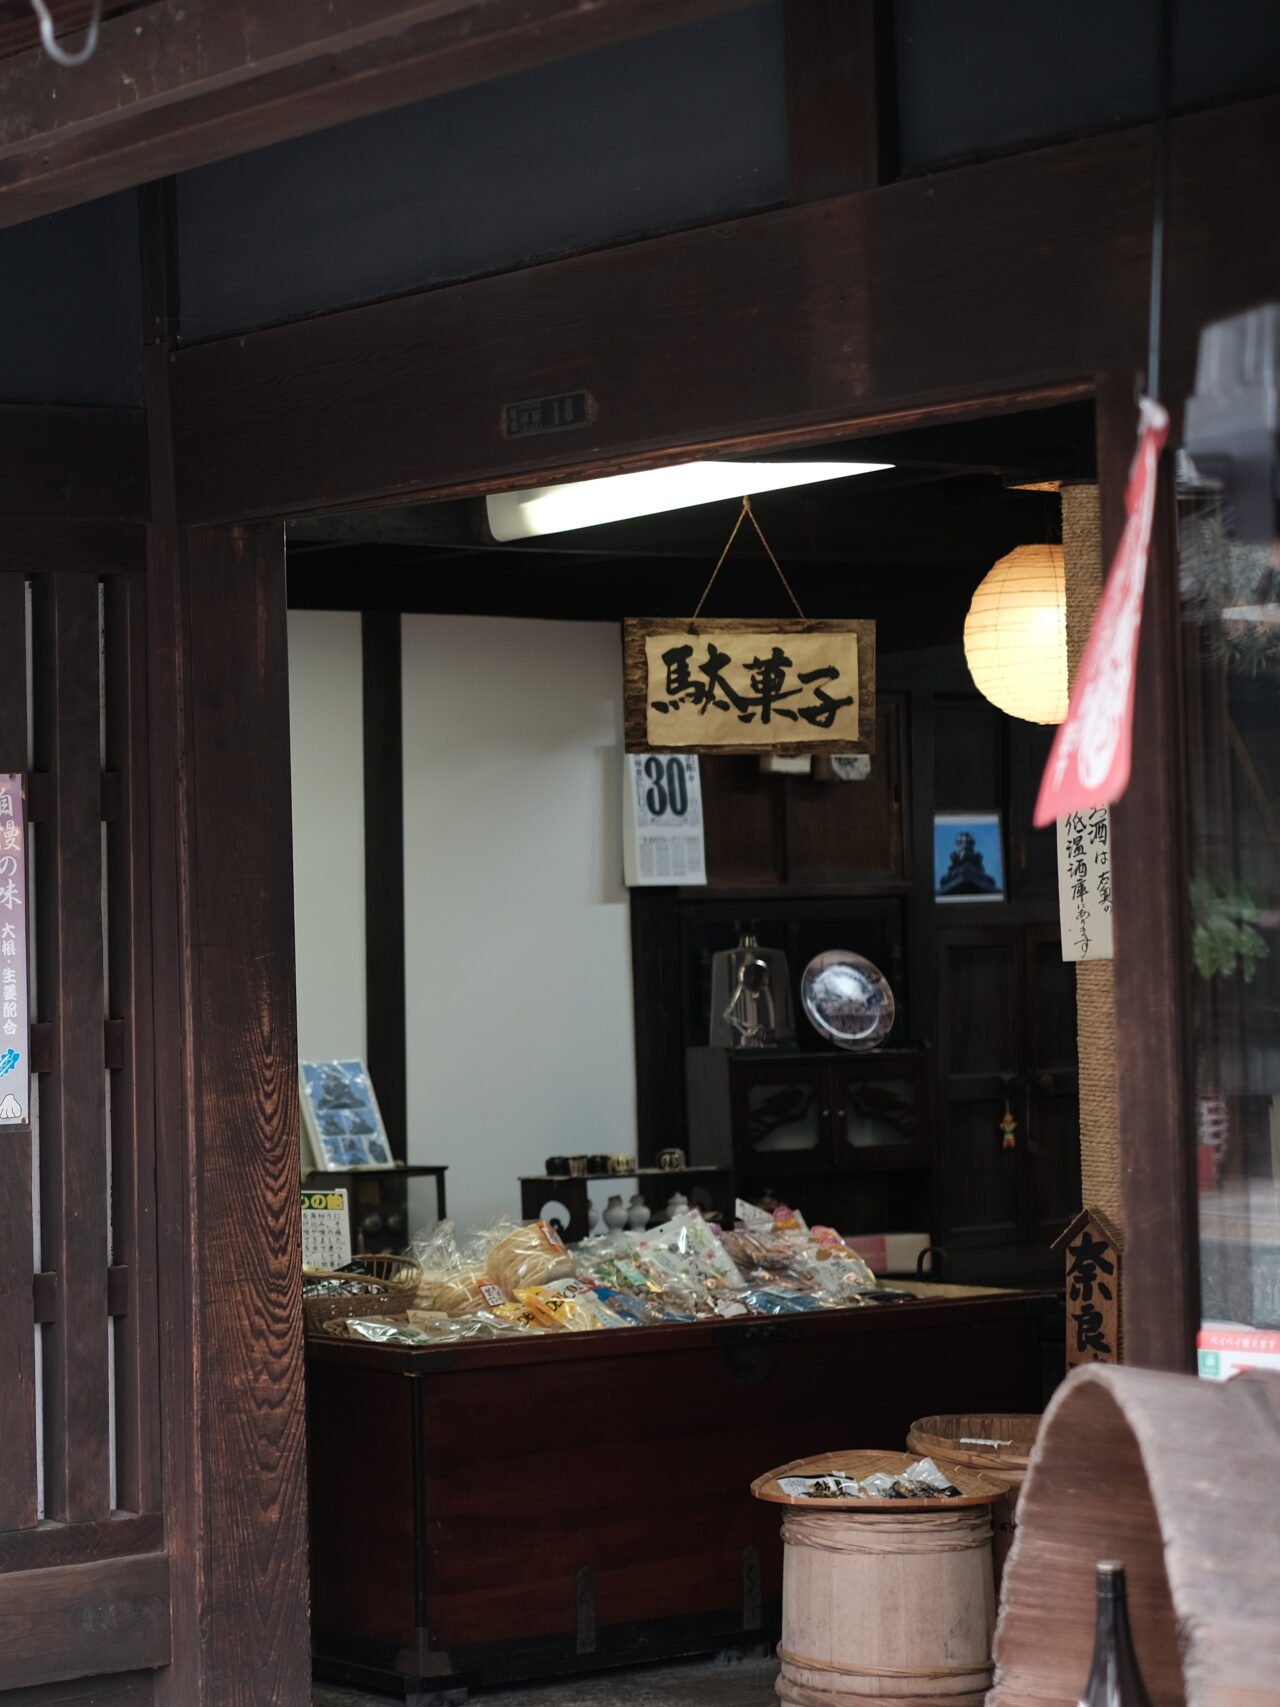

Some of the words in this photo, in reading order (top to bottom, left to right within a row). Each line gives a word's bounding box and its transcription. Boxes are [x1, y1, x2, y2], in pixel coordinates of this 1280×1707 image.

[651, 642, 854, 728] 駄菓子
[644, 756, 688, 817] 30
[1067, 1231, 1115, 1365] 奈良
